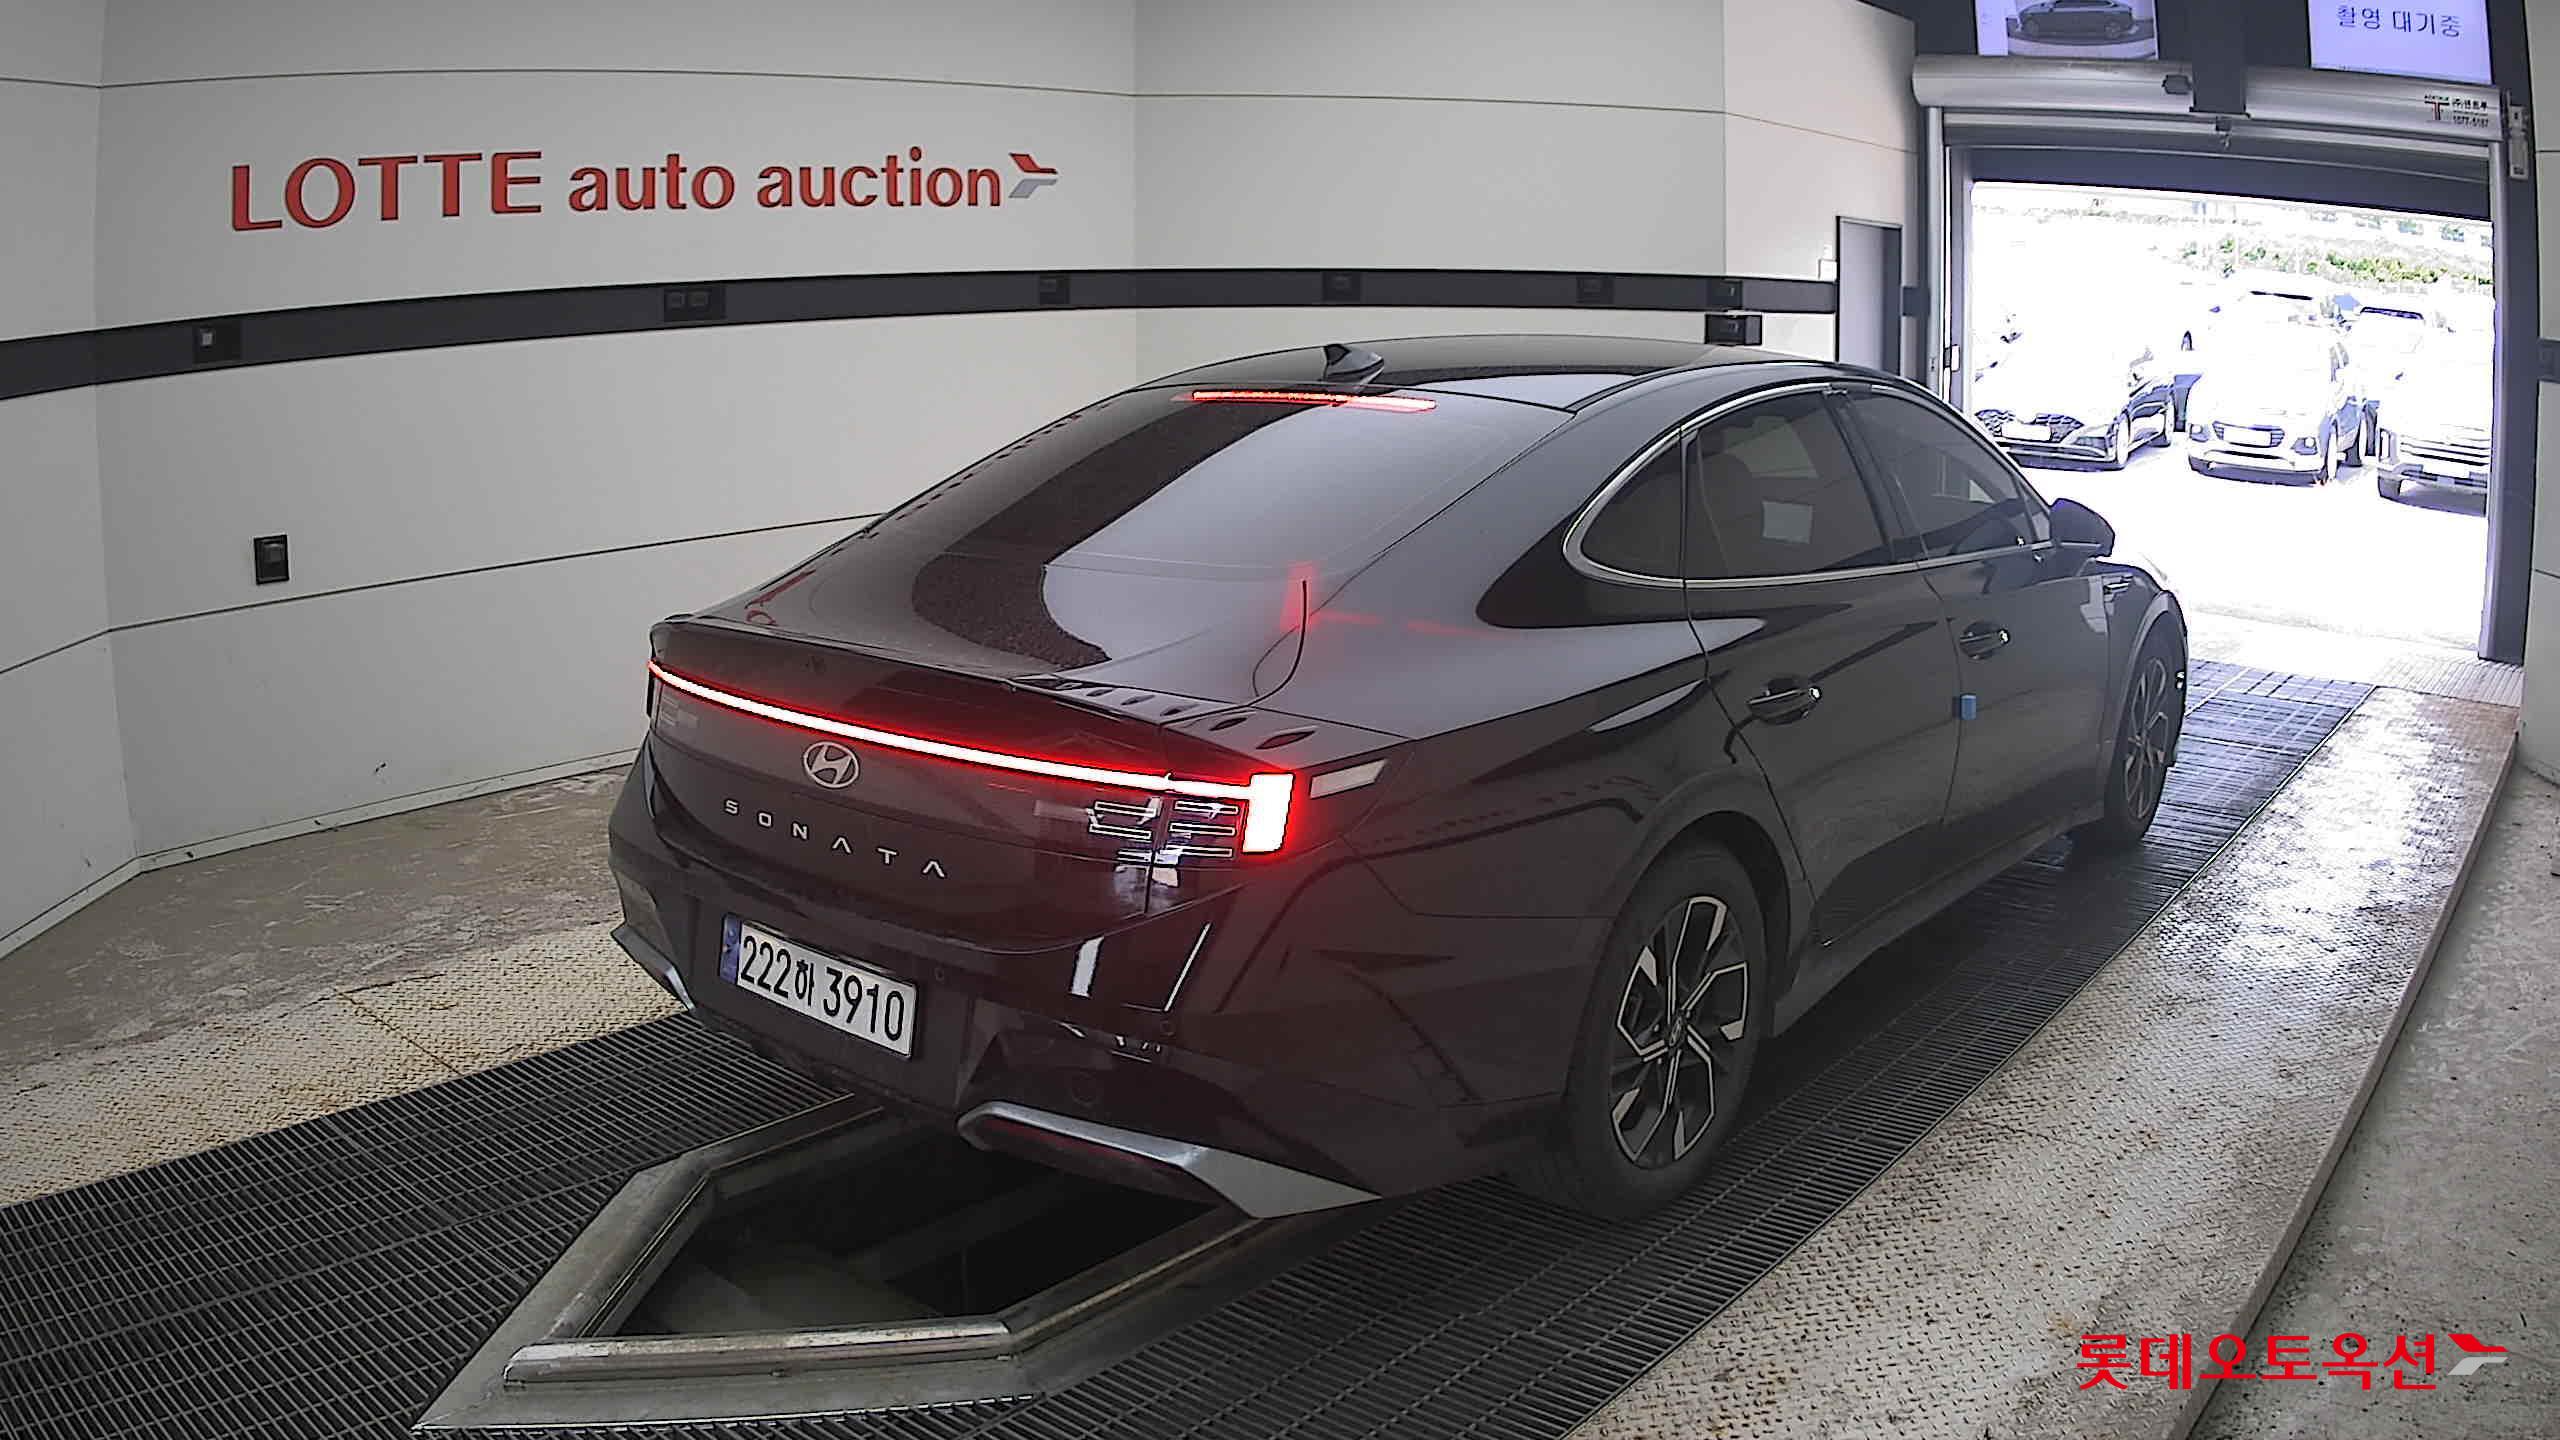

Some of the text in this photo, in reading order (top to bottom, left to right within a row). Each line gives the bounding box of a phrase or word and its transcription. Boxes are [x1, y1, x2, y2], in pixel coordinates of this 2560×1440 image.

[2337, 4, 2464, 38] 촬영 대기중
[231, 145, 1001, 233] LOTTE auto auction
[723, 798, 946, 879] SONATA
[740, 934, 905, 1042] 222하 3910
